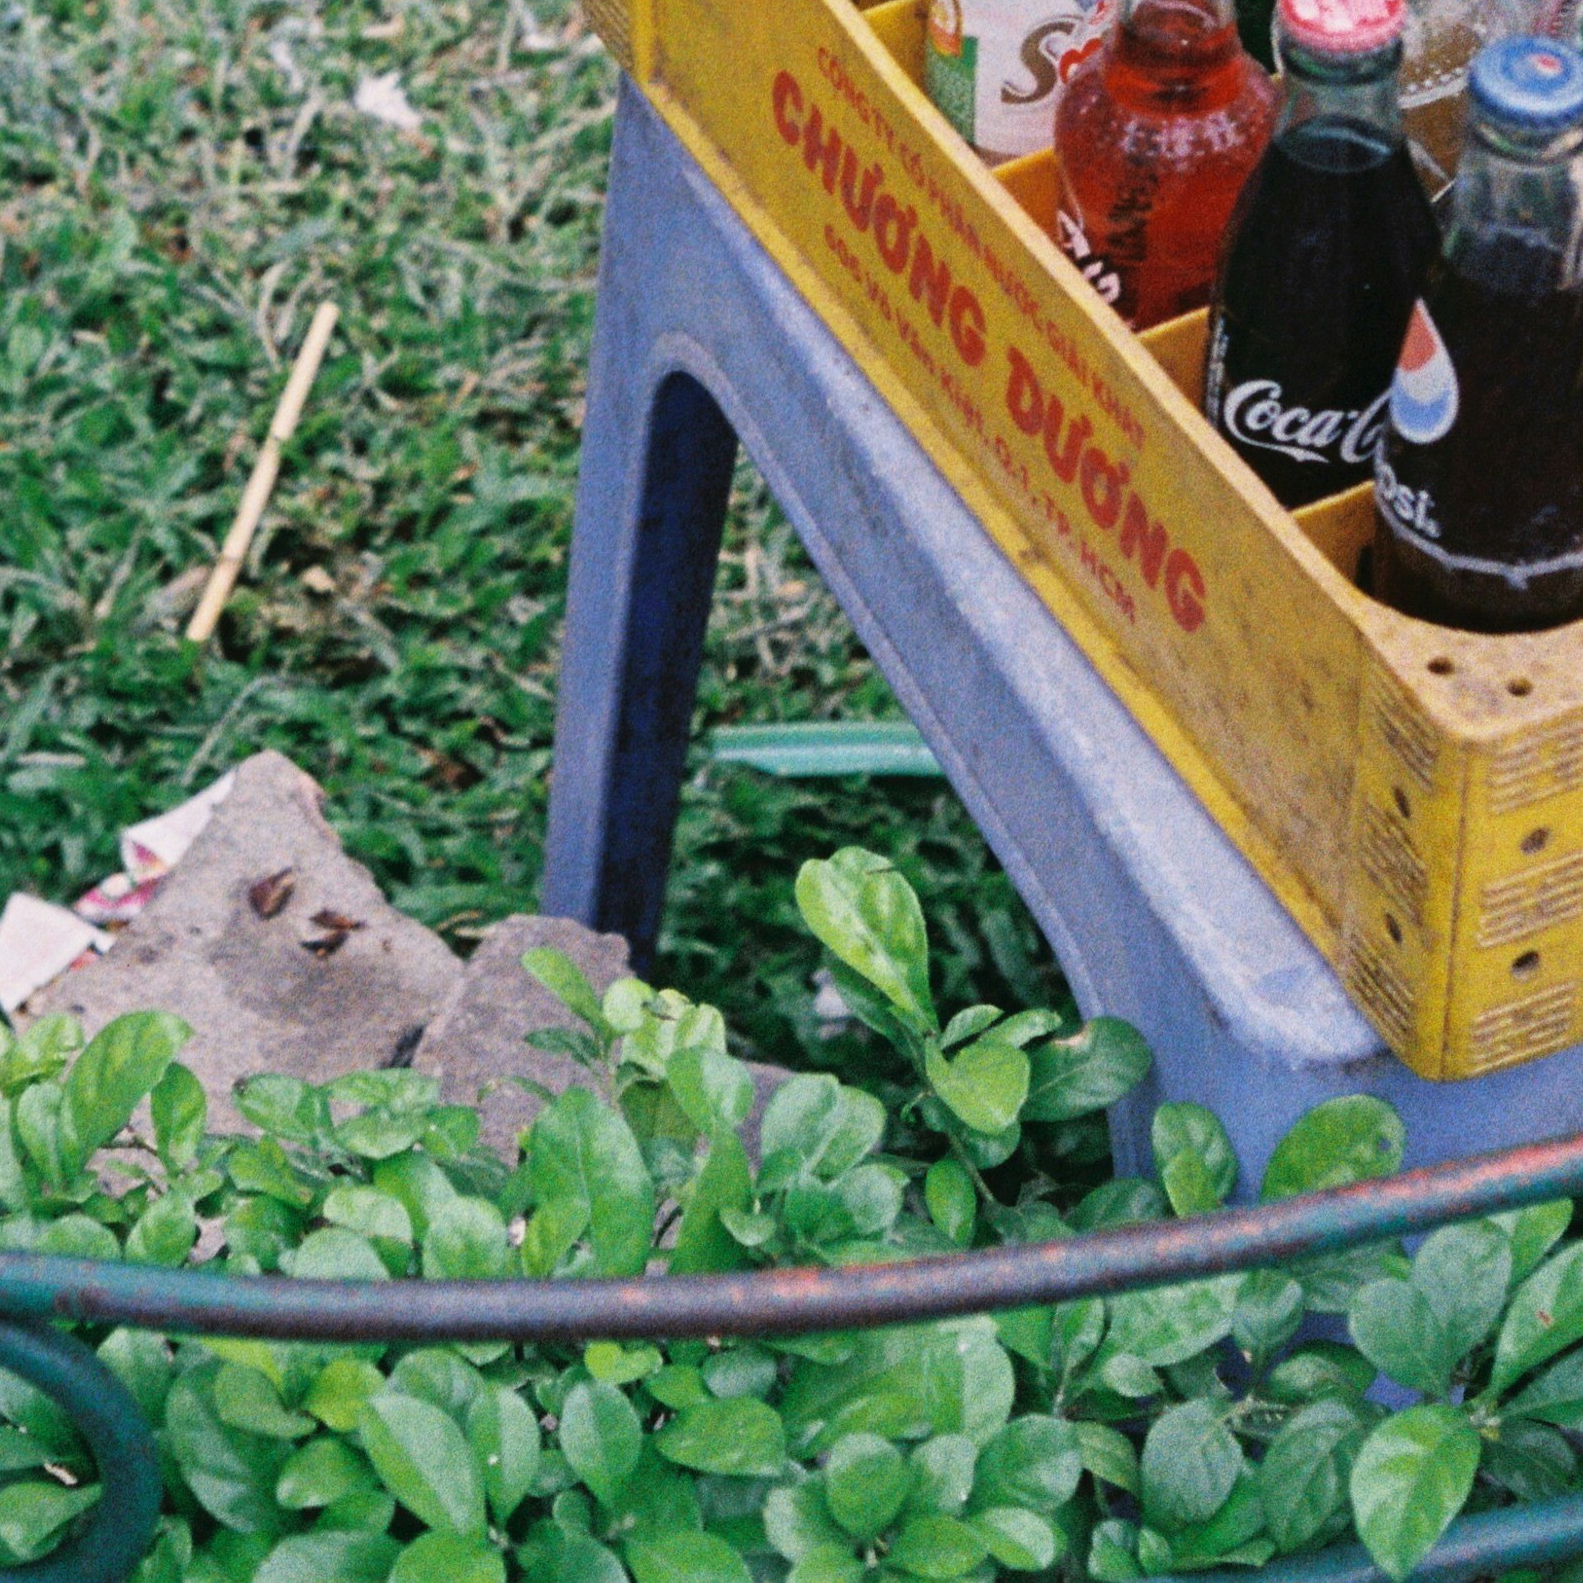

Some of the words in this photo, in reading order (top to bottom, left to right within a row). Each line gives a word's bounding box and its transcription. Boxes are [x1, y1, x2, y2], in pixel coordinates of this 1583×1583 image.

[772, 69, 986, 367] CHƯƠNG
[1006, 346, 1207, 632] DƯƠNG
[1223, 378, 1392, 464] Coca-C
